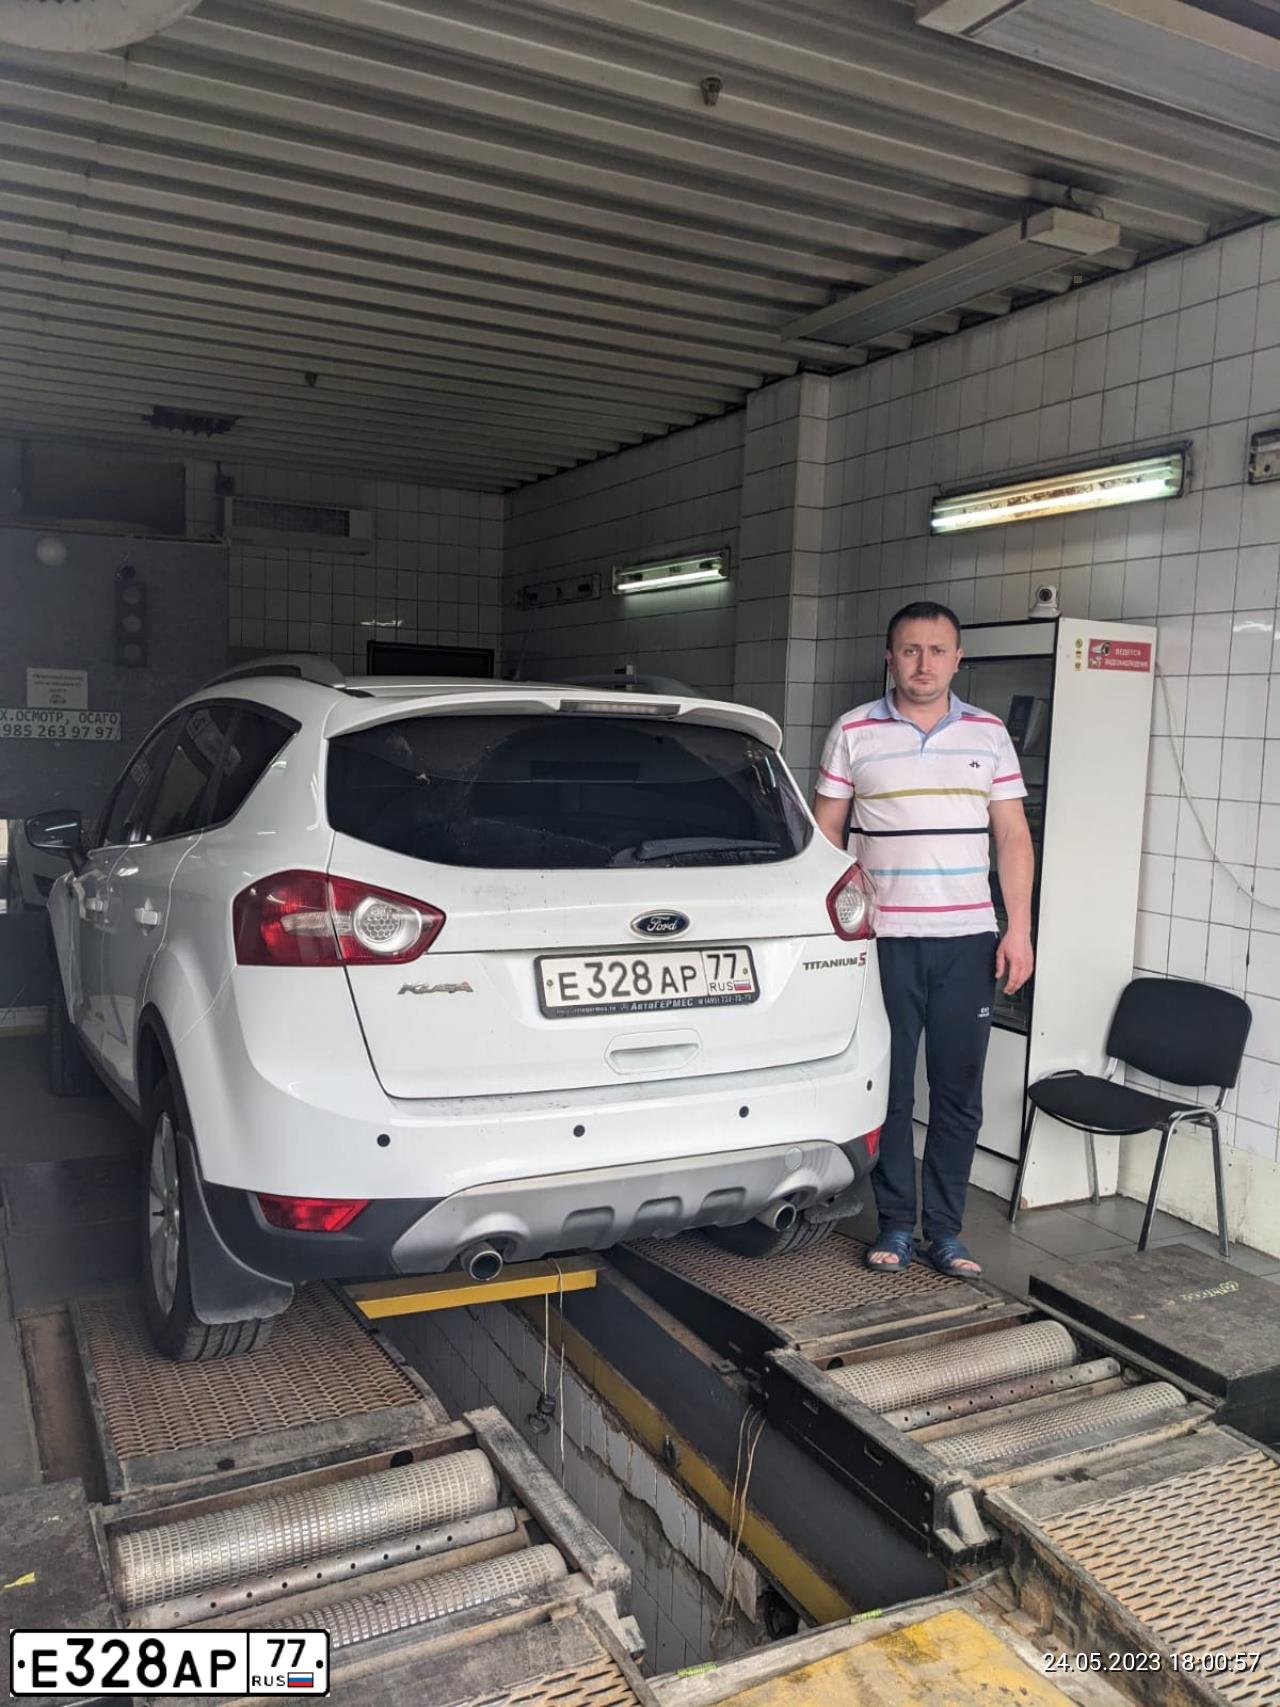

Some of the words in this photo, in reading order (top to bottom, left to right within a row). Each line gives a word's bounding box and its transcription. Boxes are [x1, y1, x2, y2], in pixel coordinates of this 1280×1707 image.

[79, 712, 118, 725] ОСАГО
[3, 723, 33, 737] 985
[37, 725, 66, 738] 263
[71, 726, 90, 738] 97
[95, 727, 113, 739] 97
[646, 916, 679, 932] Ford
[706, 953, 737, 980] 77
[709, 981, 734, 992] RUS
